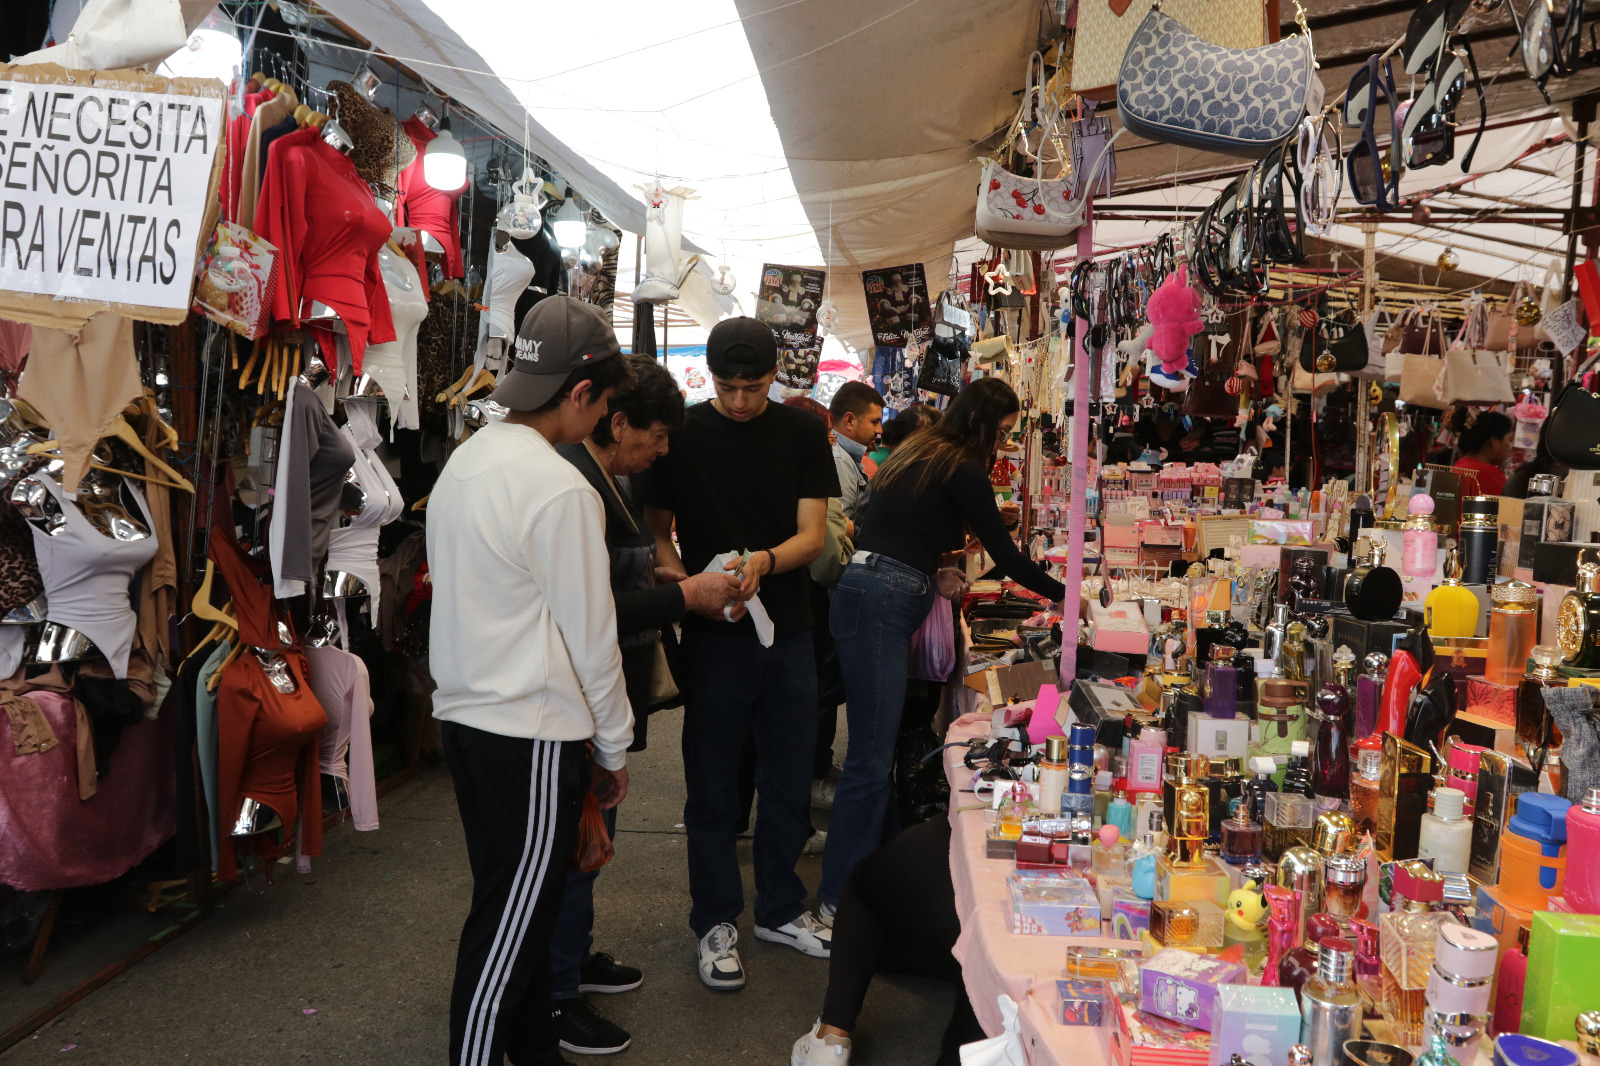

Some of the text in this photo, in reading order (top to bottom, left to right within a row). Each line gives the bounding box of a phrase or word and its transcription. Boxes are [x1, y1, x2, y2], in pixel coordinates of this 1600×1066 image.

[21, 91, 208, 154] NECESITA
[0, 141, 173, 206] EÑORITA
[57, 206, 181, 285] VENTAS
